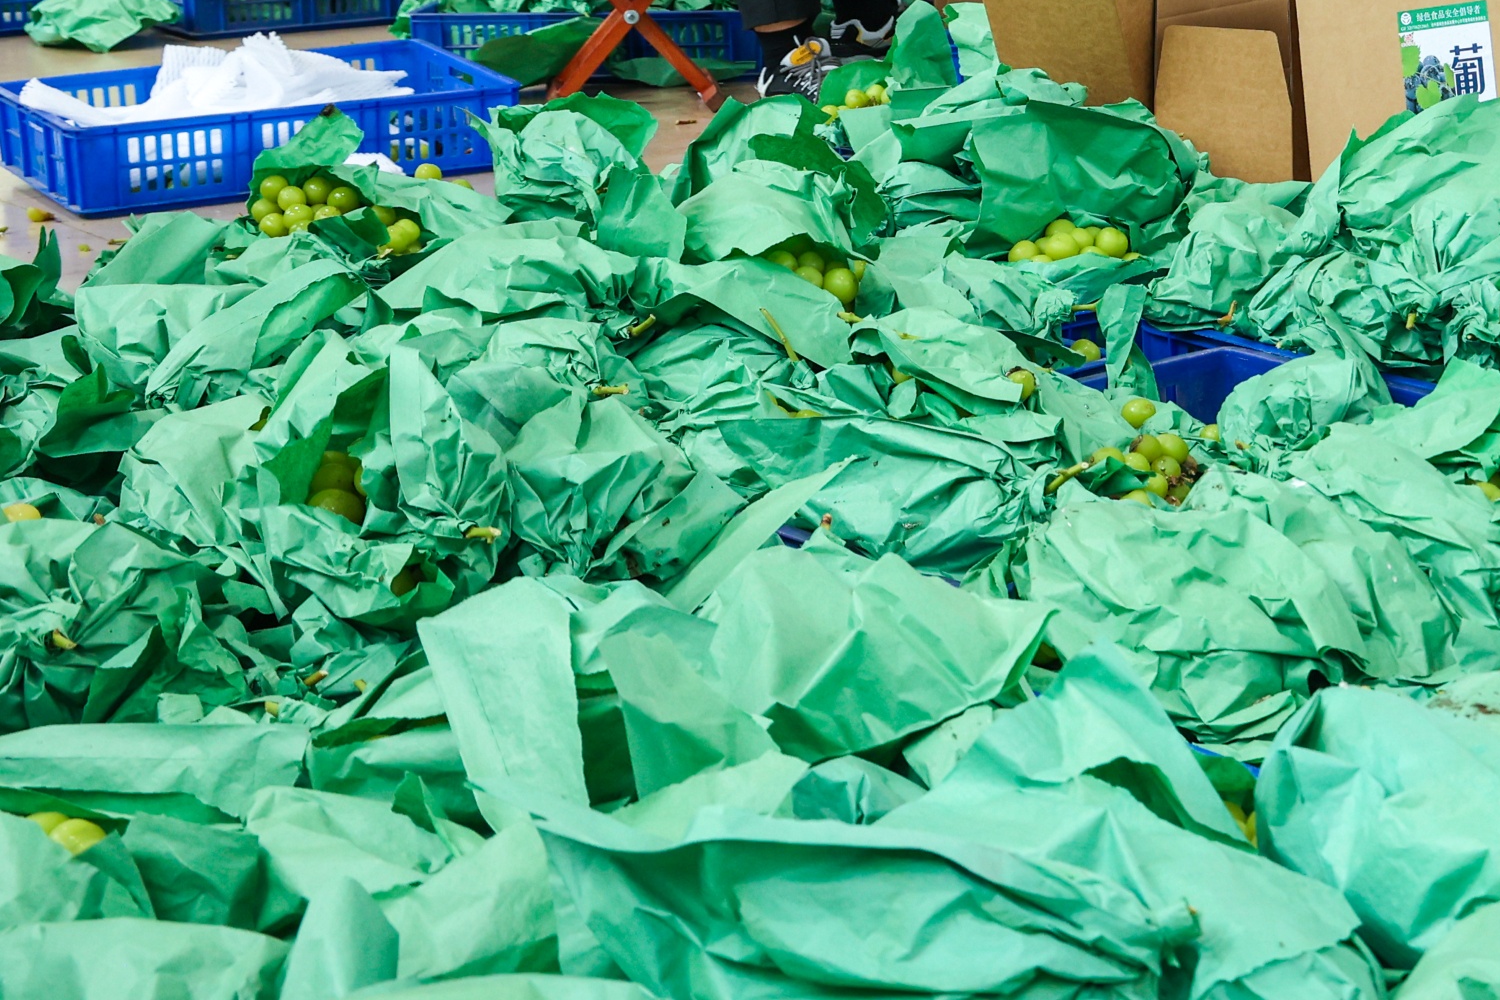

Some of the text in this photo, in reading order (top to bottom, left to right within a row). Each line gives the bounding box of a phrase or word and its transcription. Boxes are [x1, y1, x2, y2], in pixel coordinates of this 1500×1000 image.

[1416, 4, 1480, 21] 绿色食品安全倡导者
[1449, 43, 1485, 95] 葡
